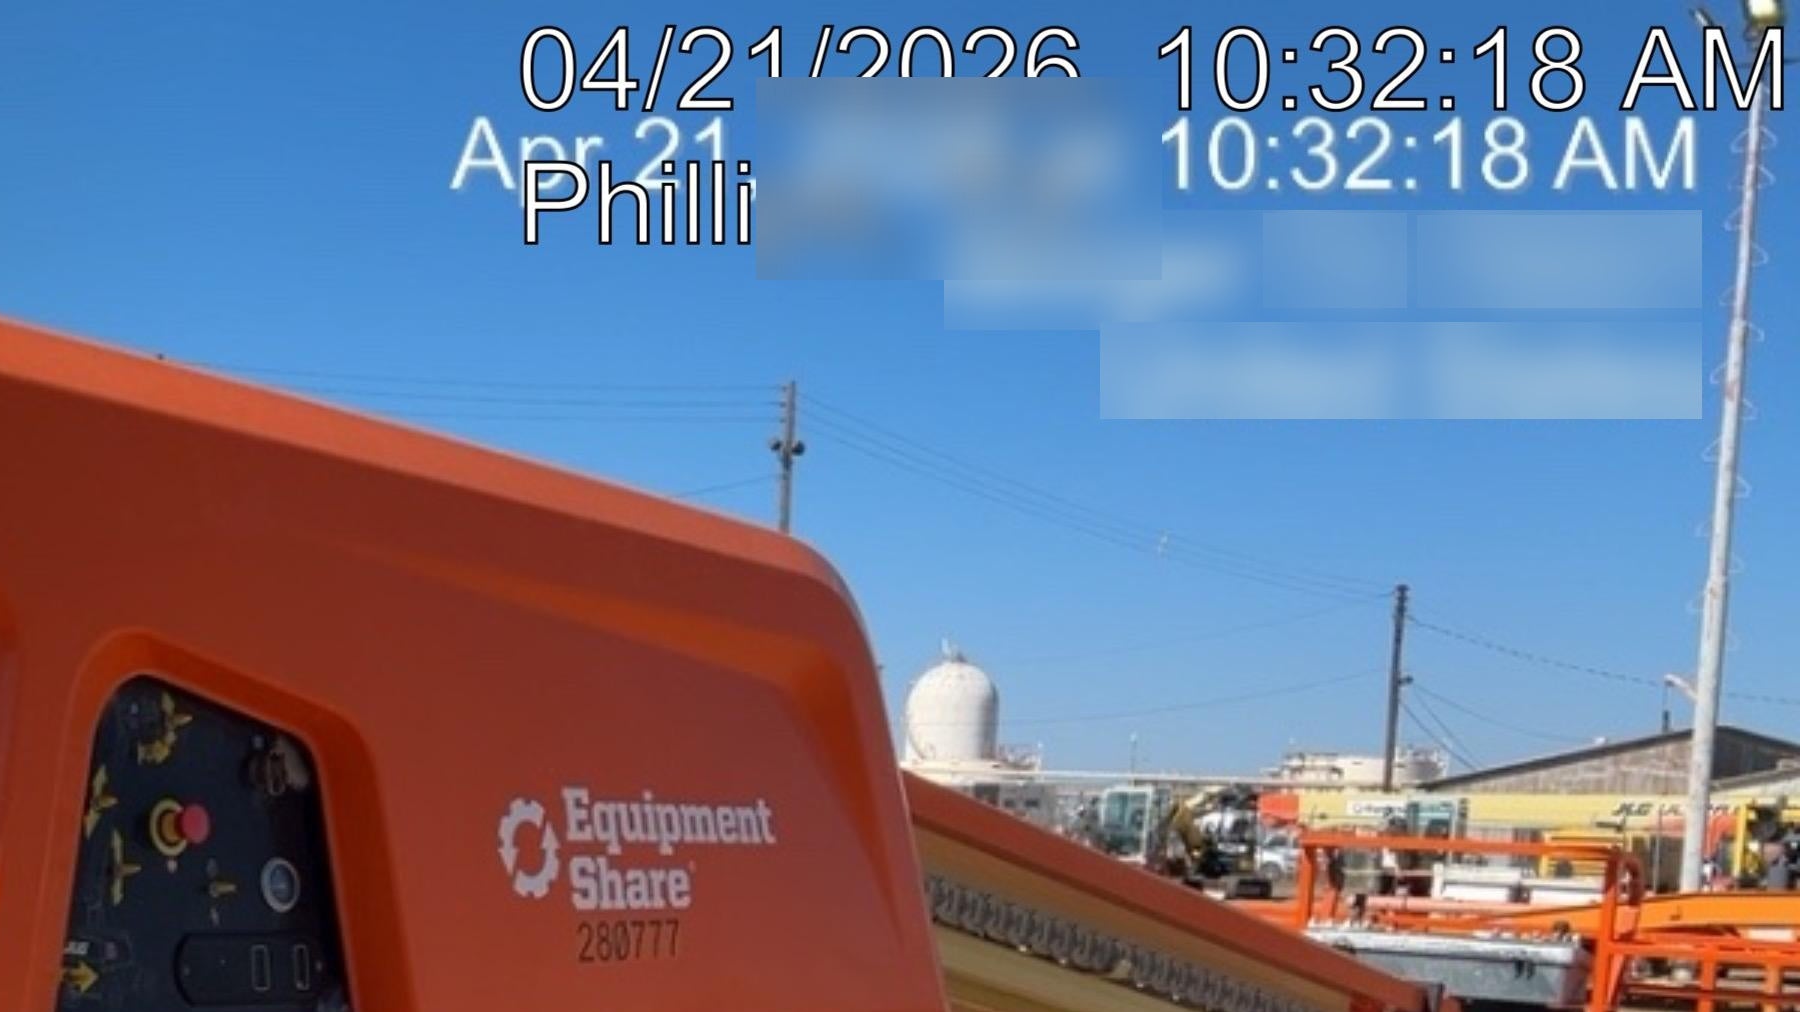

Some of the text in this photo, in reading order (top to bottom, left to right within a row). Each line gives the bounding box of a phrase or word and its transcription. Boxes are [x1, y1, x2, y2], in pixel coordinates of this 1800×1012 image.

[562, 787, 777, 856] Equipment
[569, 855, 692, 911] Share
[577, 919, 680, 963] 280777
